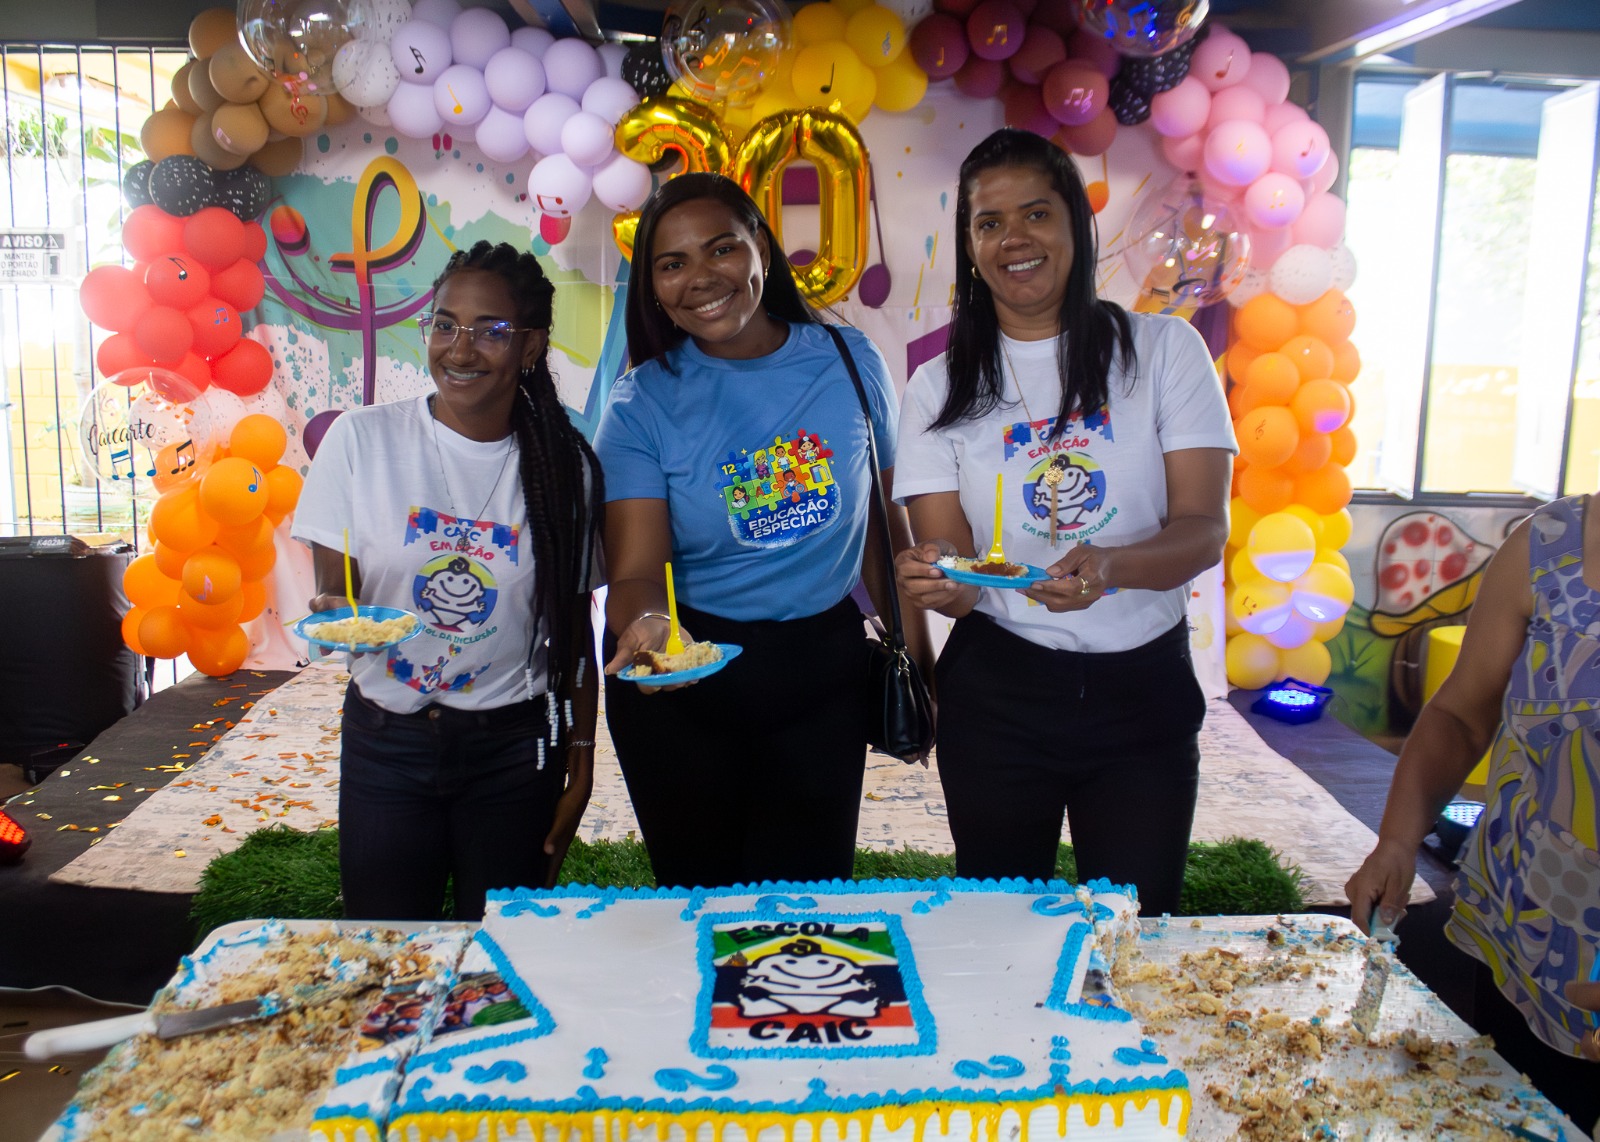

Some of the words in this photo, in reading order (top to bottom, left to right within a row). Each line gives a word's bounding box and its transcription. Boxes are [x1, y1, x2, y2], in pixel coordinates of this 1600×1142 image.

[2, 235, 43, 248] AVISO
[4, 252, 35, 260] MANTER
[2, 269, 37, 277] FECHADO
[1027, 445, 1051, 459] EM
[1052, 435, 1090, 452] AÇÃO
[748, 498, 829, 532] EDUCAÇÃO
[753, 511, 826, 539] ESPECIAL
[1021, 522, 1037, 536] EM
[1036, 530, 1063, 541] PRL
[1064, 532, 1078, 541] DA
[1078, 506, 1119, 540] INCLUSÃO
[429, 540, 453, 551] EM
[438, 632, 452, 642] DA
[453, 625, 498, 645] INCLUSÃO
[727, 922, 870, 944] ESCOLA
[749, 1019, 873, 1044] CAIC
